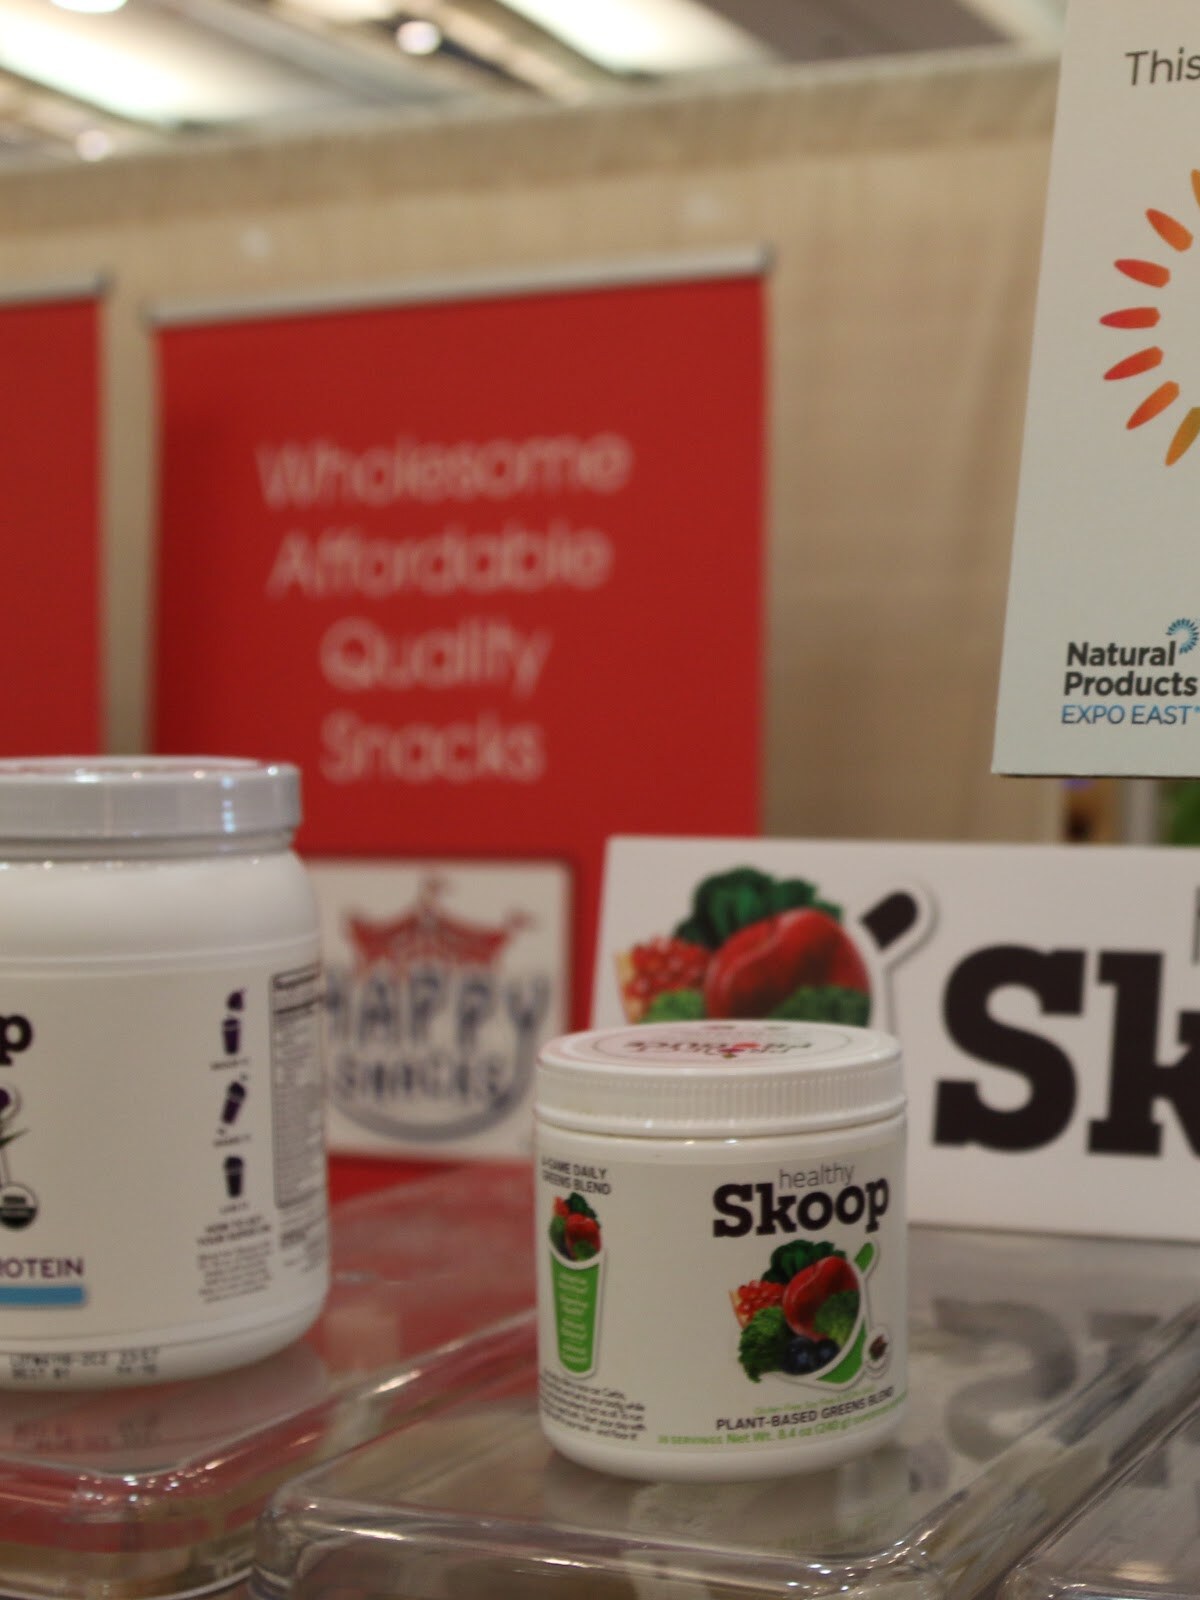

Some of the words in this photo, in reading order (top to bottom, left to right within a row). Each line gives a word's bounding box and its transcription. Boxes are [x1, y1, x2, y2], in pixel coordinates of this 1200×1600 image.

[257, 433, 632, 509] Wholesome
[266, 521, 612, 598] Affordable
[319, 618, 551, 699] Quality
[1066, 640, 1176, 667] Natural
[1063, 670, 1198, 696] Products
[1061, 704, 1125, 724] EXPO
[320, 710, 546, 784] Snacks
[573, 1163, 607, 1180] DAILY
[573, 1178, 612, 1195] BLEND
[779, 1163, 855, 1189] healthy
[713, 1177, 890, 1238] Skoop
[716, 1409, 818, 1430] PLANT-BASED
[821, 1397, 866, 1419] GREENS
